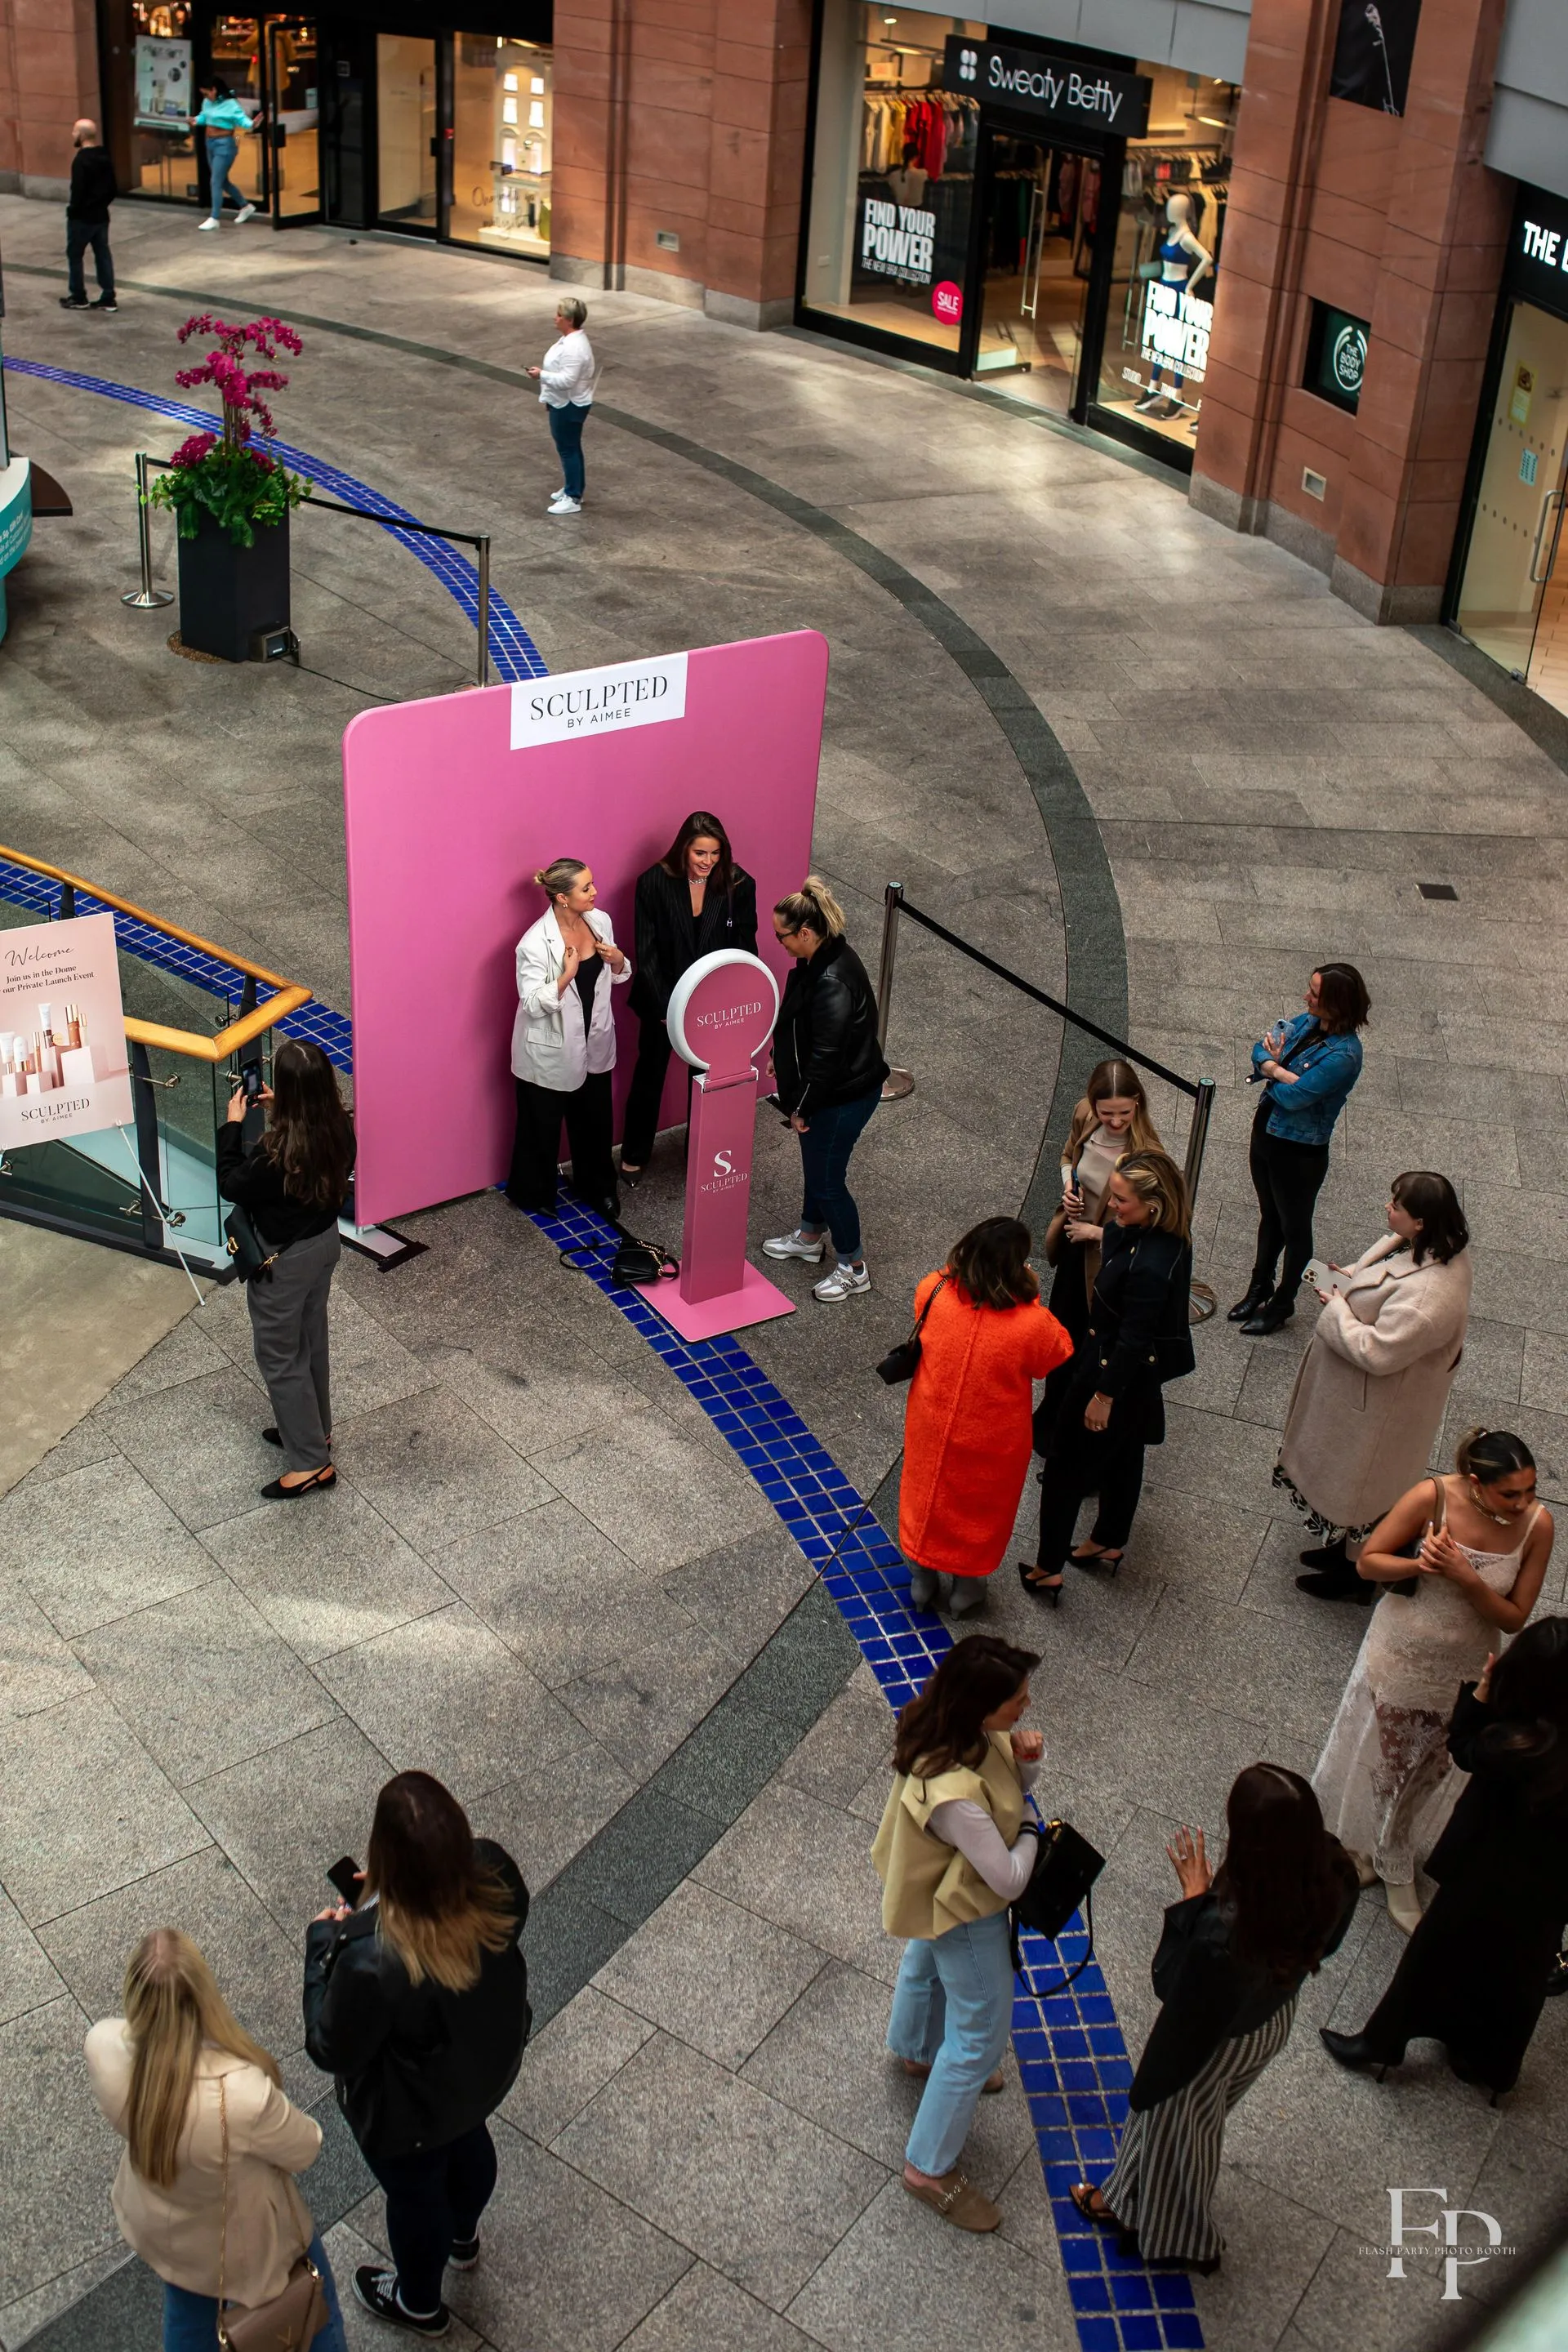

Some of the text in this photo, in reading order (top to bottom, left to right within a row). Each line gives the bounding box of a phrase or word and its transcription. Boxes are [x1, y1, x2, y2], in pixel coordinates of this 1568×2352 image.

[988, 55, 1124, 122] Sweaty Betty
[864, 198, 937, 239] FIND YOUR
[862, 222, 934, 273] POWER
[1523, 220, 1561, 266] THE
[937, 291, 960, 312] SALE
[1146, 279, 1214, 333] FIND YOUR
[1142, 306, 1209, 371] POWER
[1346, 343, 1359, 357] THE
[1339, 352, 1361, 371] BODY
[1339, 363, 1359, 381] SHOP
[531, 675, 668, 721] SCULPTED
[568, 707, 631, 728] BY AIMEE
[4, 945, 74, 966] Welcome
[7, 974, 21, 984] Join
[42, 969, 54, 977] the
[55, 965, 77, 974] Dome
[17, 982, 44, 991] Private
[45, 975, 73, 987] Launch
[74, 971, 95, 981] Event
[697, 1001, 761, 1027] SCULPTED
[725, 1018, 745, 1027] AIMEE
[21, 1098, 91, 1122] SCULPTED
[52, 1112, 74, 1121] AIMEE
[714, 1150, 737, 1178] S.
[701, 1173, 748, 1192] SCULPTED
